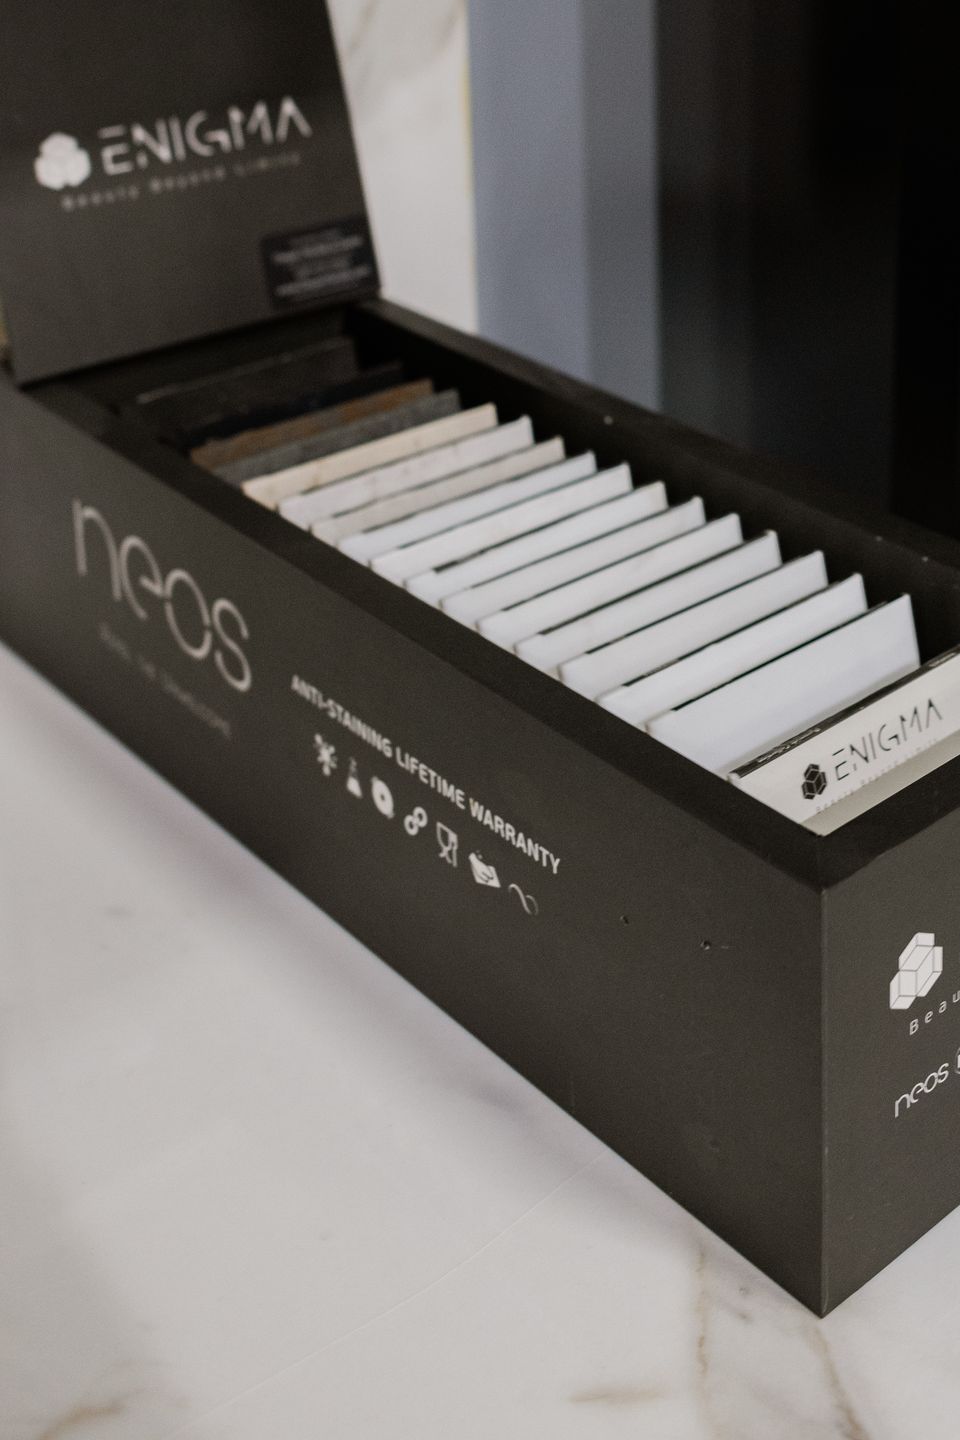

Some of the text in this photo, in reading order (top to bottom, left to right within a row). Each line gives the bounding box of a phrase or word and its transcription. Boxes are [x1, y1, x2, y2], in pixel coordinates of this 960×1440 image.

[98, 95, 313, 176] ENIGMA
[72, 497, 252, 692] neos
[291, 674, 392, 759] ANTI-STAINING
[395, 747, 466, 809] LIFETIME
[469, 797, 561, 874] WARRANTY
[832, 698, 943, 781] ENIGMA
[894, 1063, 949, 1118] neos
